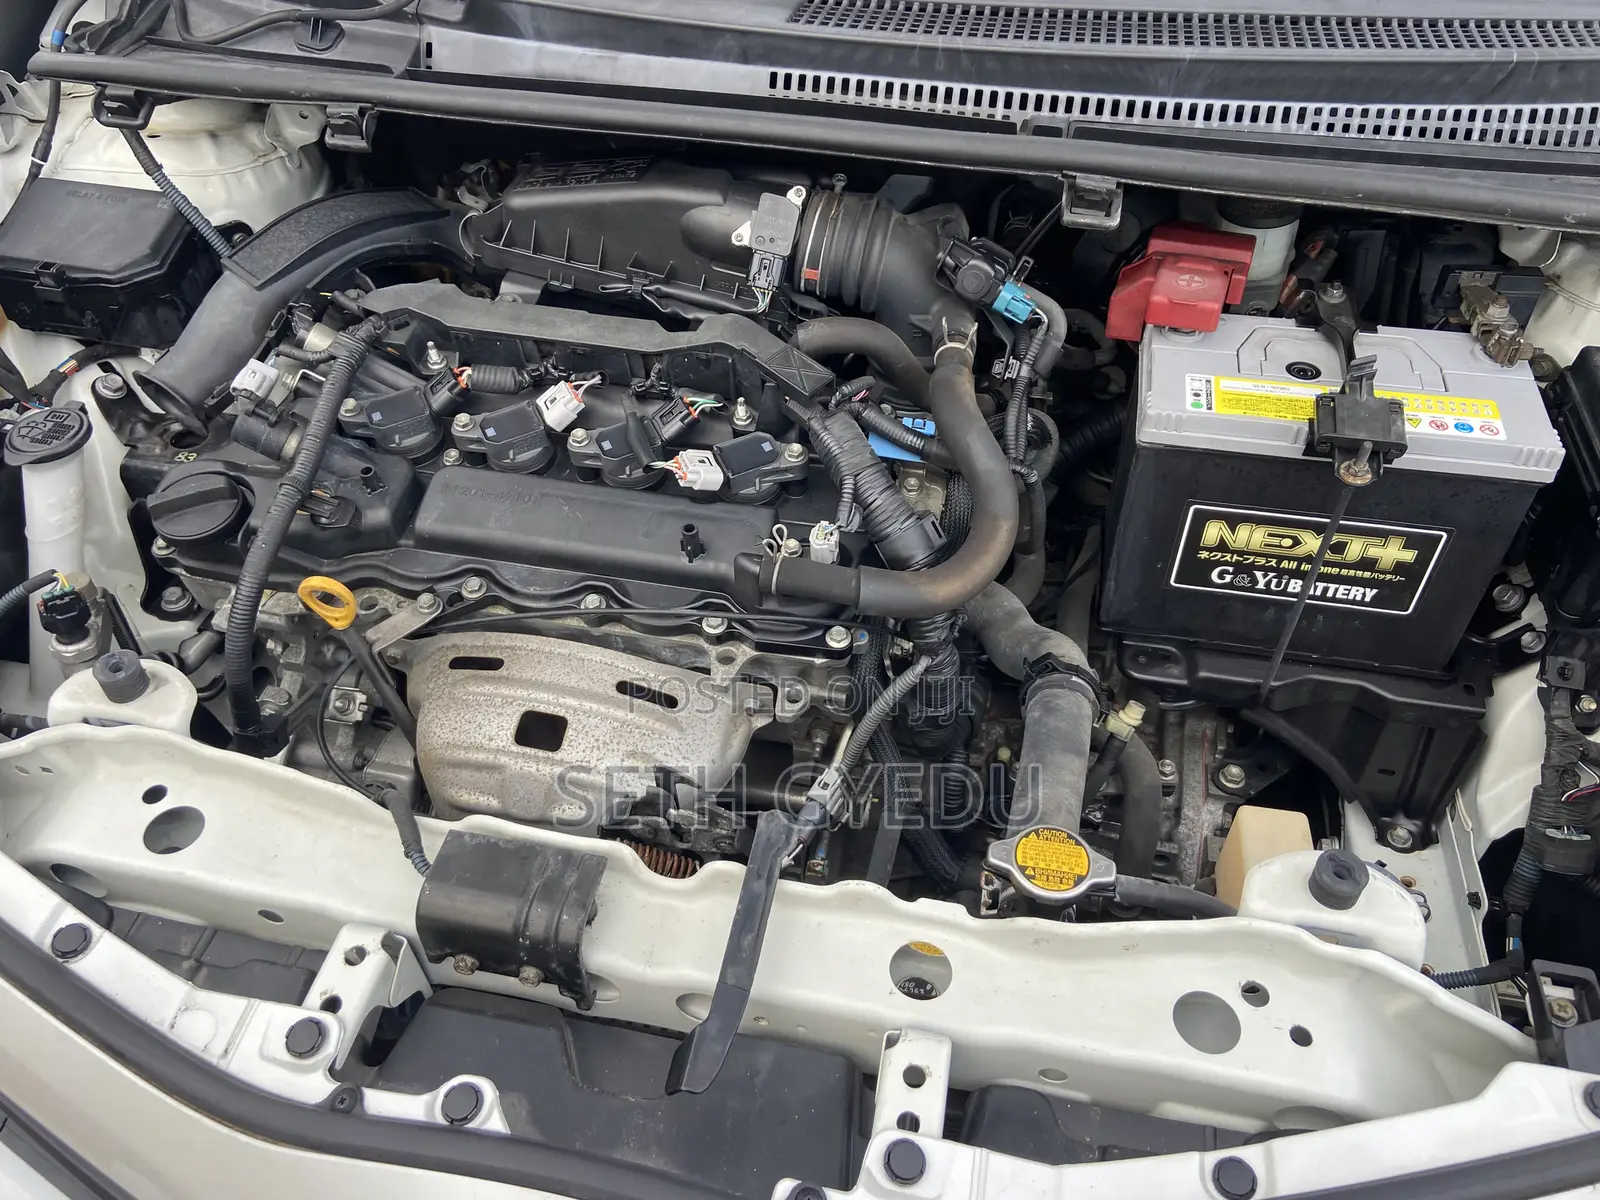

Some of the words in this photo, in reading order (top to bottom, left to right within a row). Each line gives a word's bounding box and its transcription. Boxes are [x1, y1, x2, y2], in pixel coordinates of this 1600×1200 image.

[174, 451, 198, 463] 83
[1197, 550, 1278, 568] ネクストプラス
[1280, 559, 1298, 571] All
[1038, 828, 1068, 839] CAUTION
[1038, 834, 1076, 846] ATTENTION
